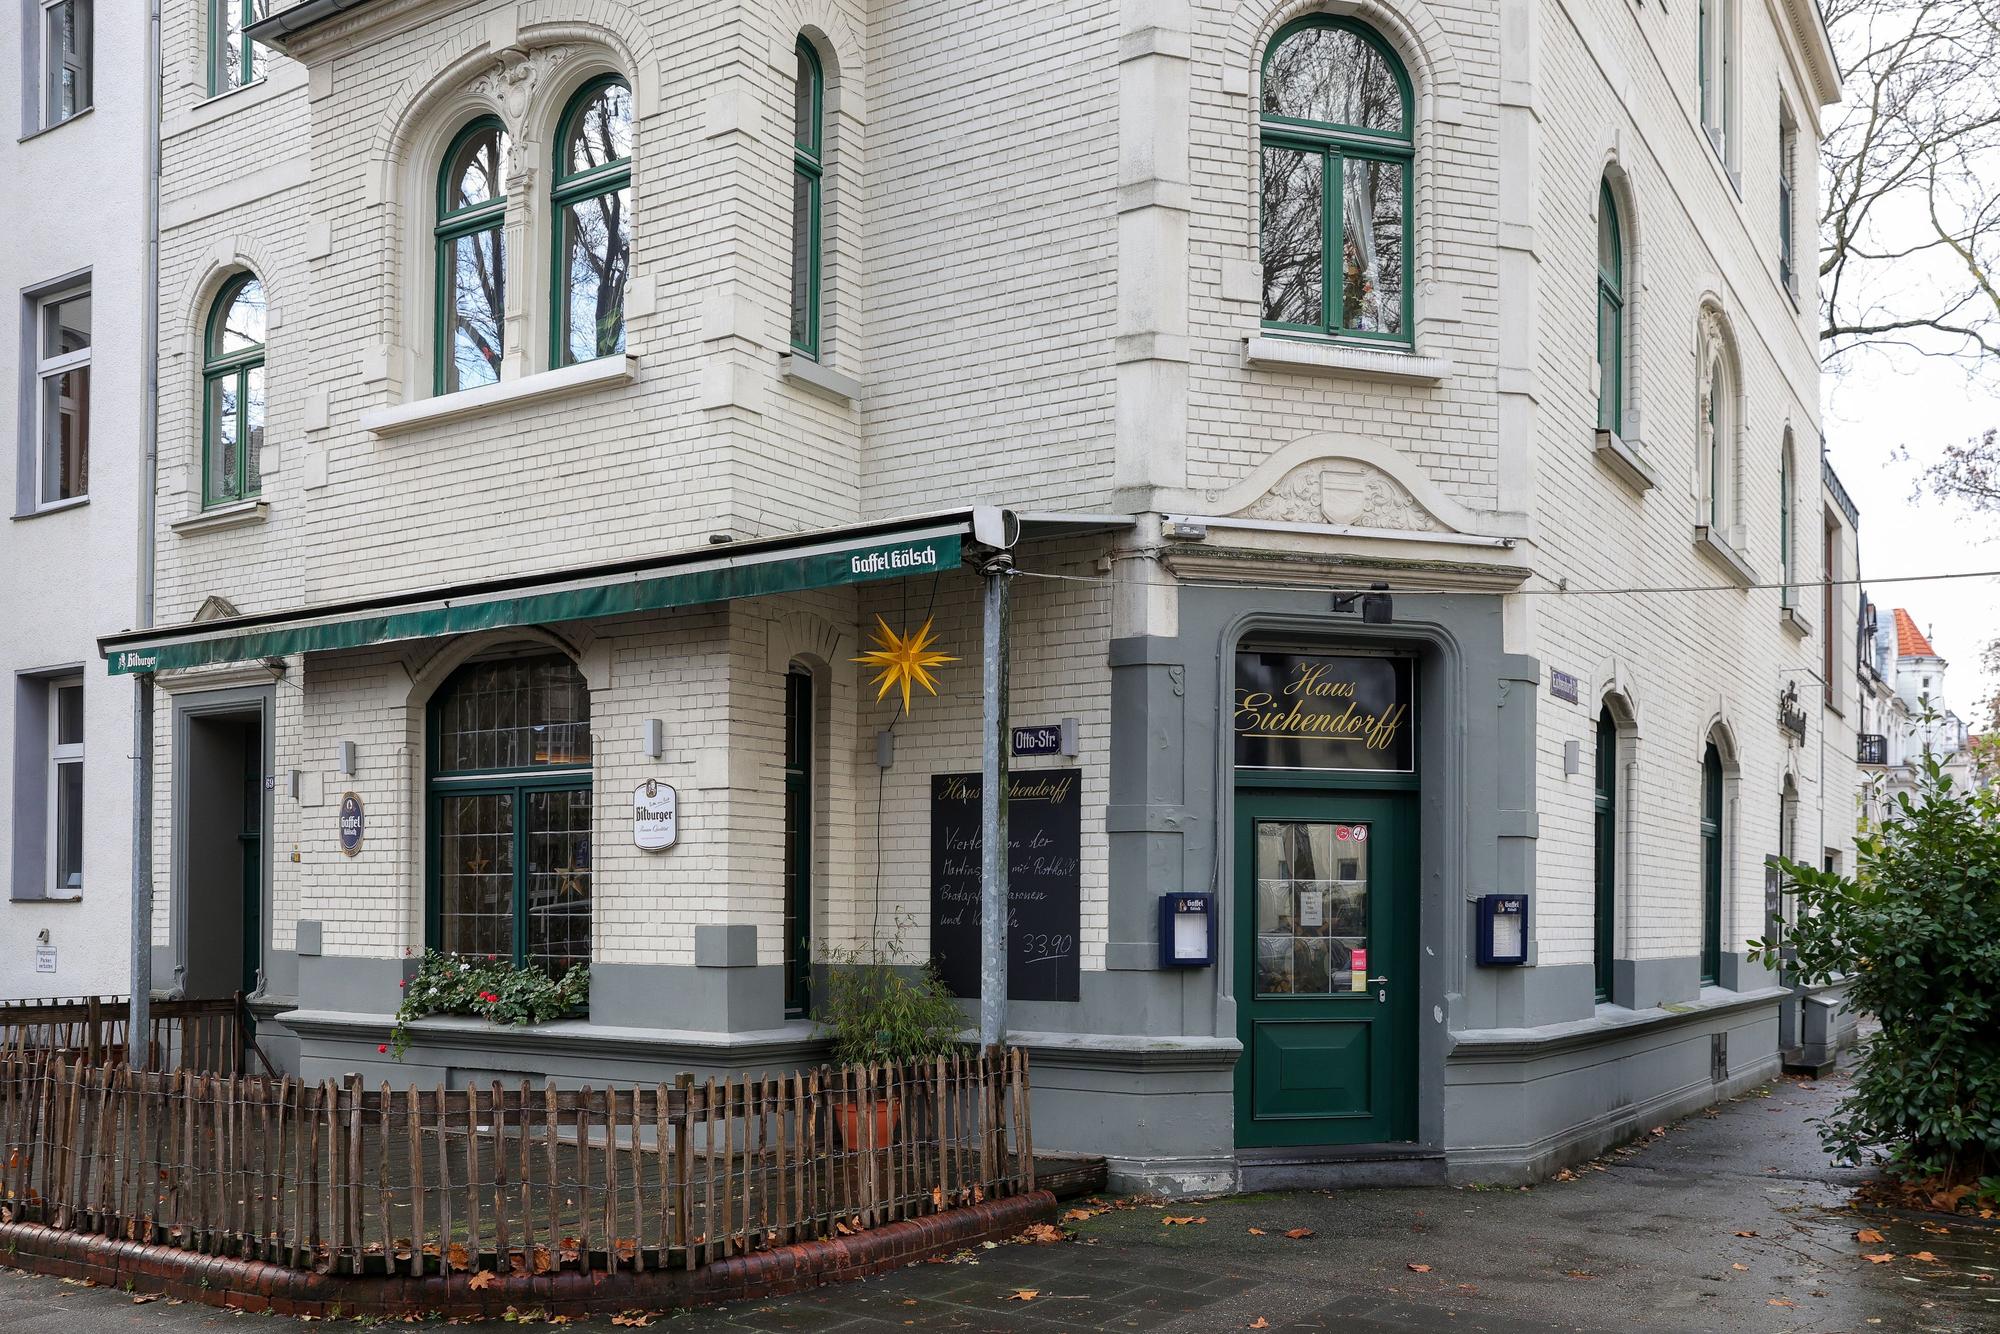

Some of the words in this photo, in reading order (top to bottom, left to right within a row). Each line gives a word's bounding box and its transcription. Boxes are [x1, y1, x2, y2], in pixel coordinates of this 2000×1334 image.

[851, 551, 890, 573] Gaffel
[891, 545, 936, 568] Kölsch
[127, 652, 156, 667] Bitburger
[1283, 663, 1356, 697] Haus
[1234, 688, 1407, 750] Eichendorff
[1015, 730, 1056, 749] Otto-Str.
[938, 776, 981, 800] Haus
[341, 815, 361, 829] Gaffel
[636, 806, 673, 823] Bitburger
[945, 826, 982, 850] Vierte
[1007, 838, 1021, 850] on
[1023, 933, 1072, 956] 33,90
